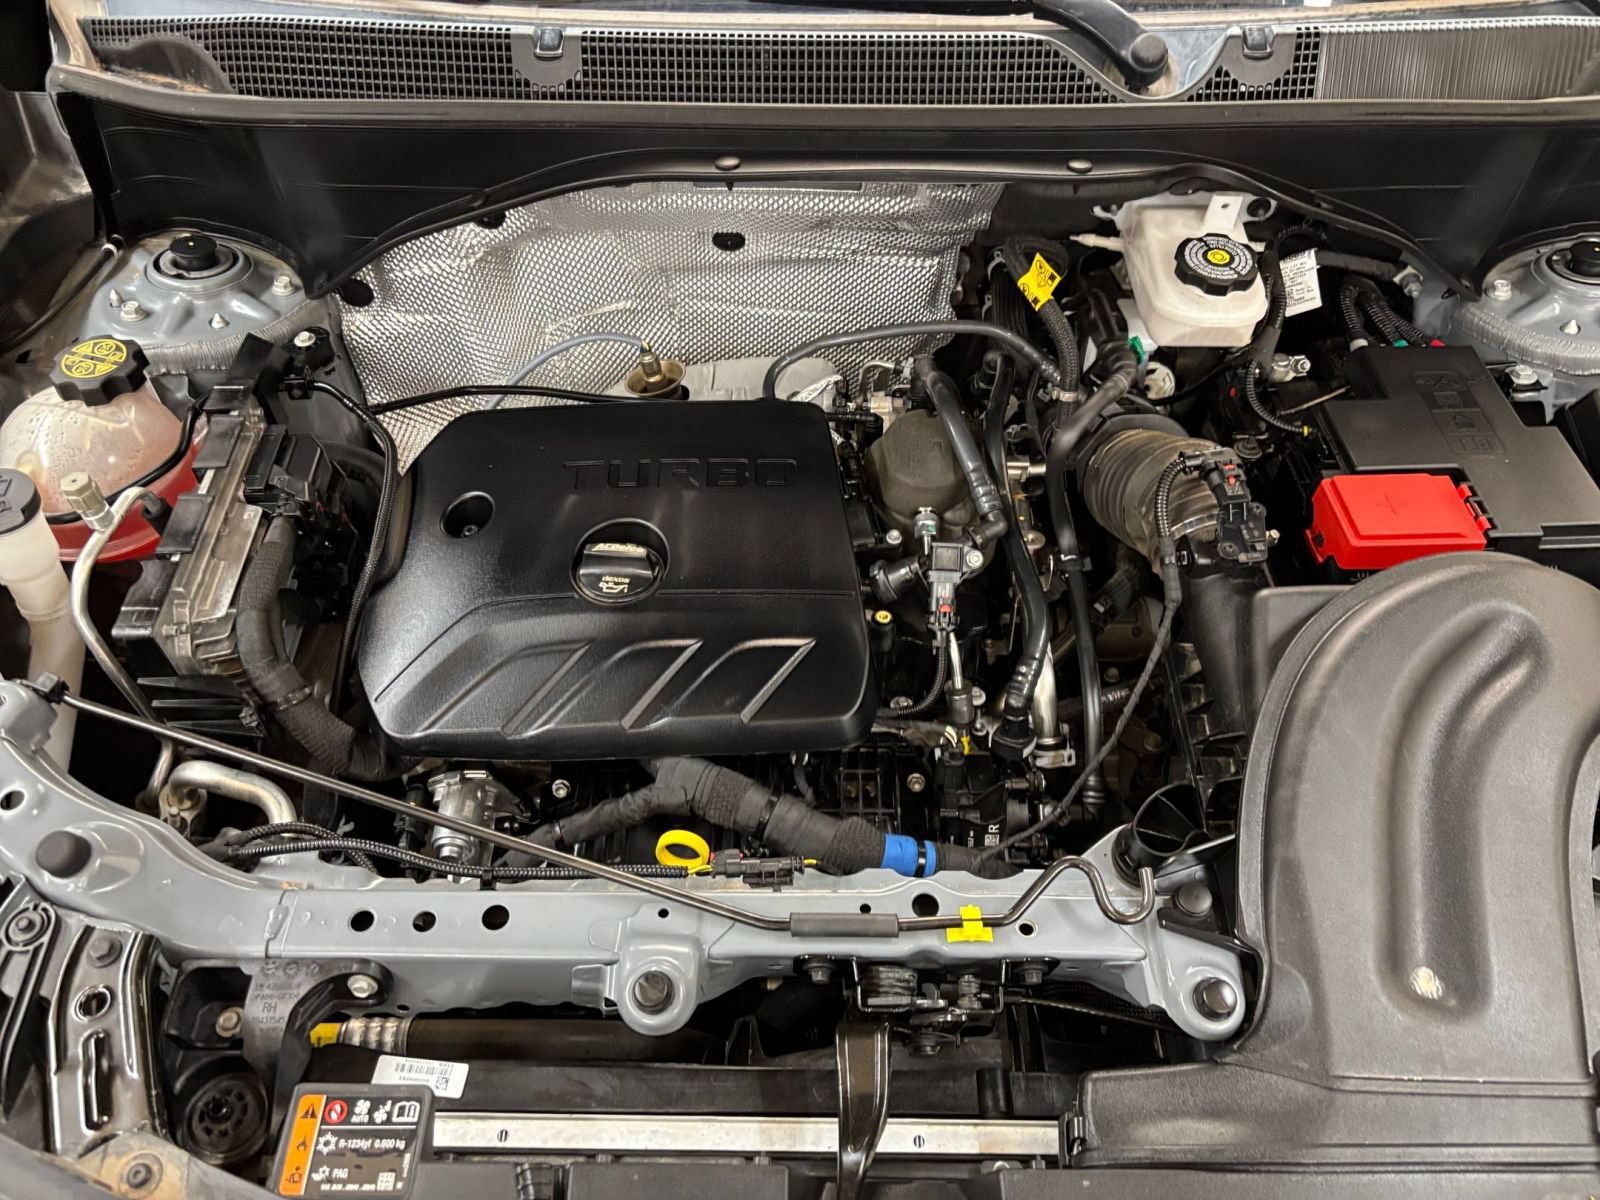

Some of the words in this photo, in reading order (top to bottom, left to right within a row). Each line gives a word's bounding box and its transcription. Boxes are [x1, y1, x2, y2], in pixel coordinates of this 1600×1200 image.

[563, 457, 799, 490] TURBO
[601, 575, 631, 583] dexos
[350, 1114, 370, 1123] AUTO
[332, 1168, 349, 1179] PAG
